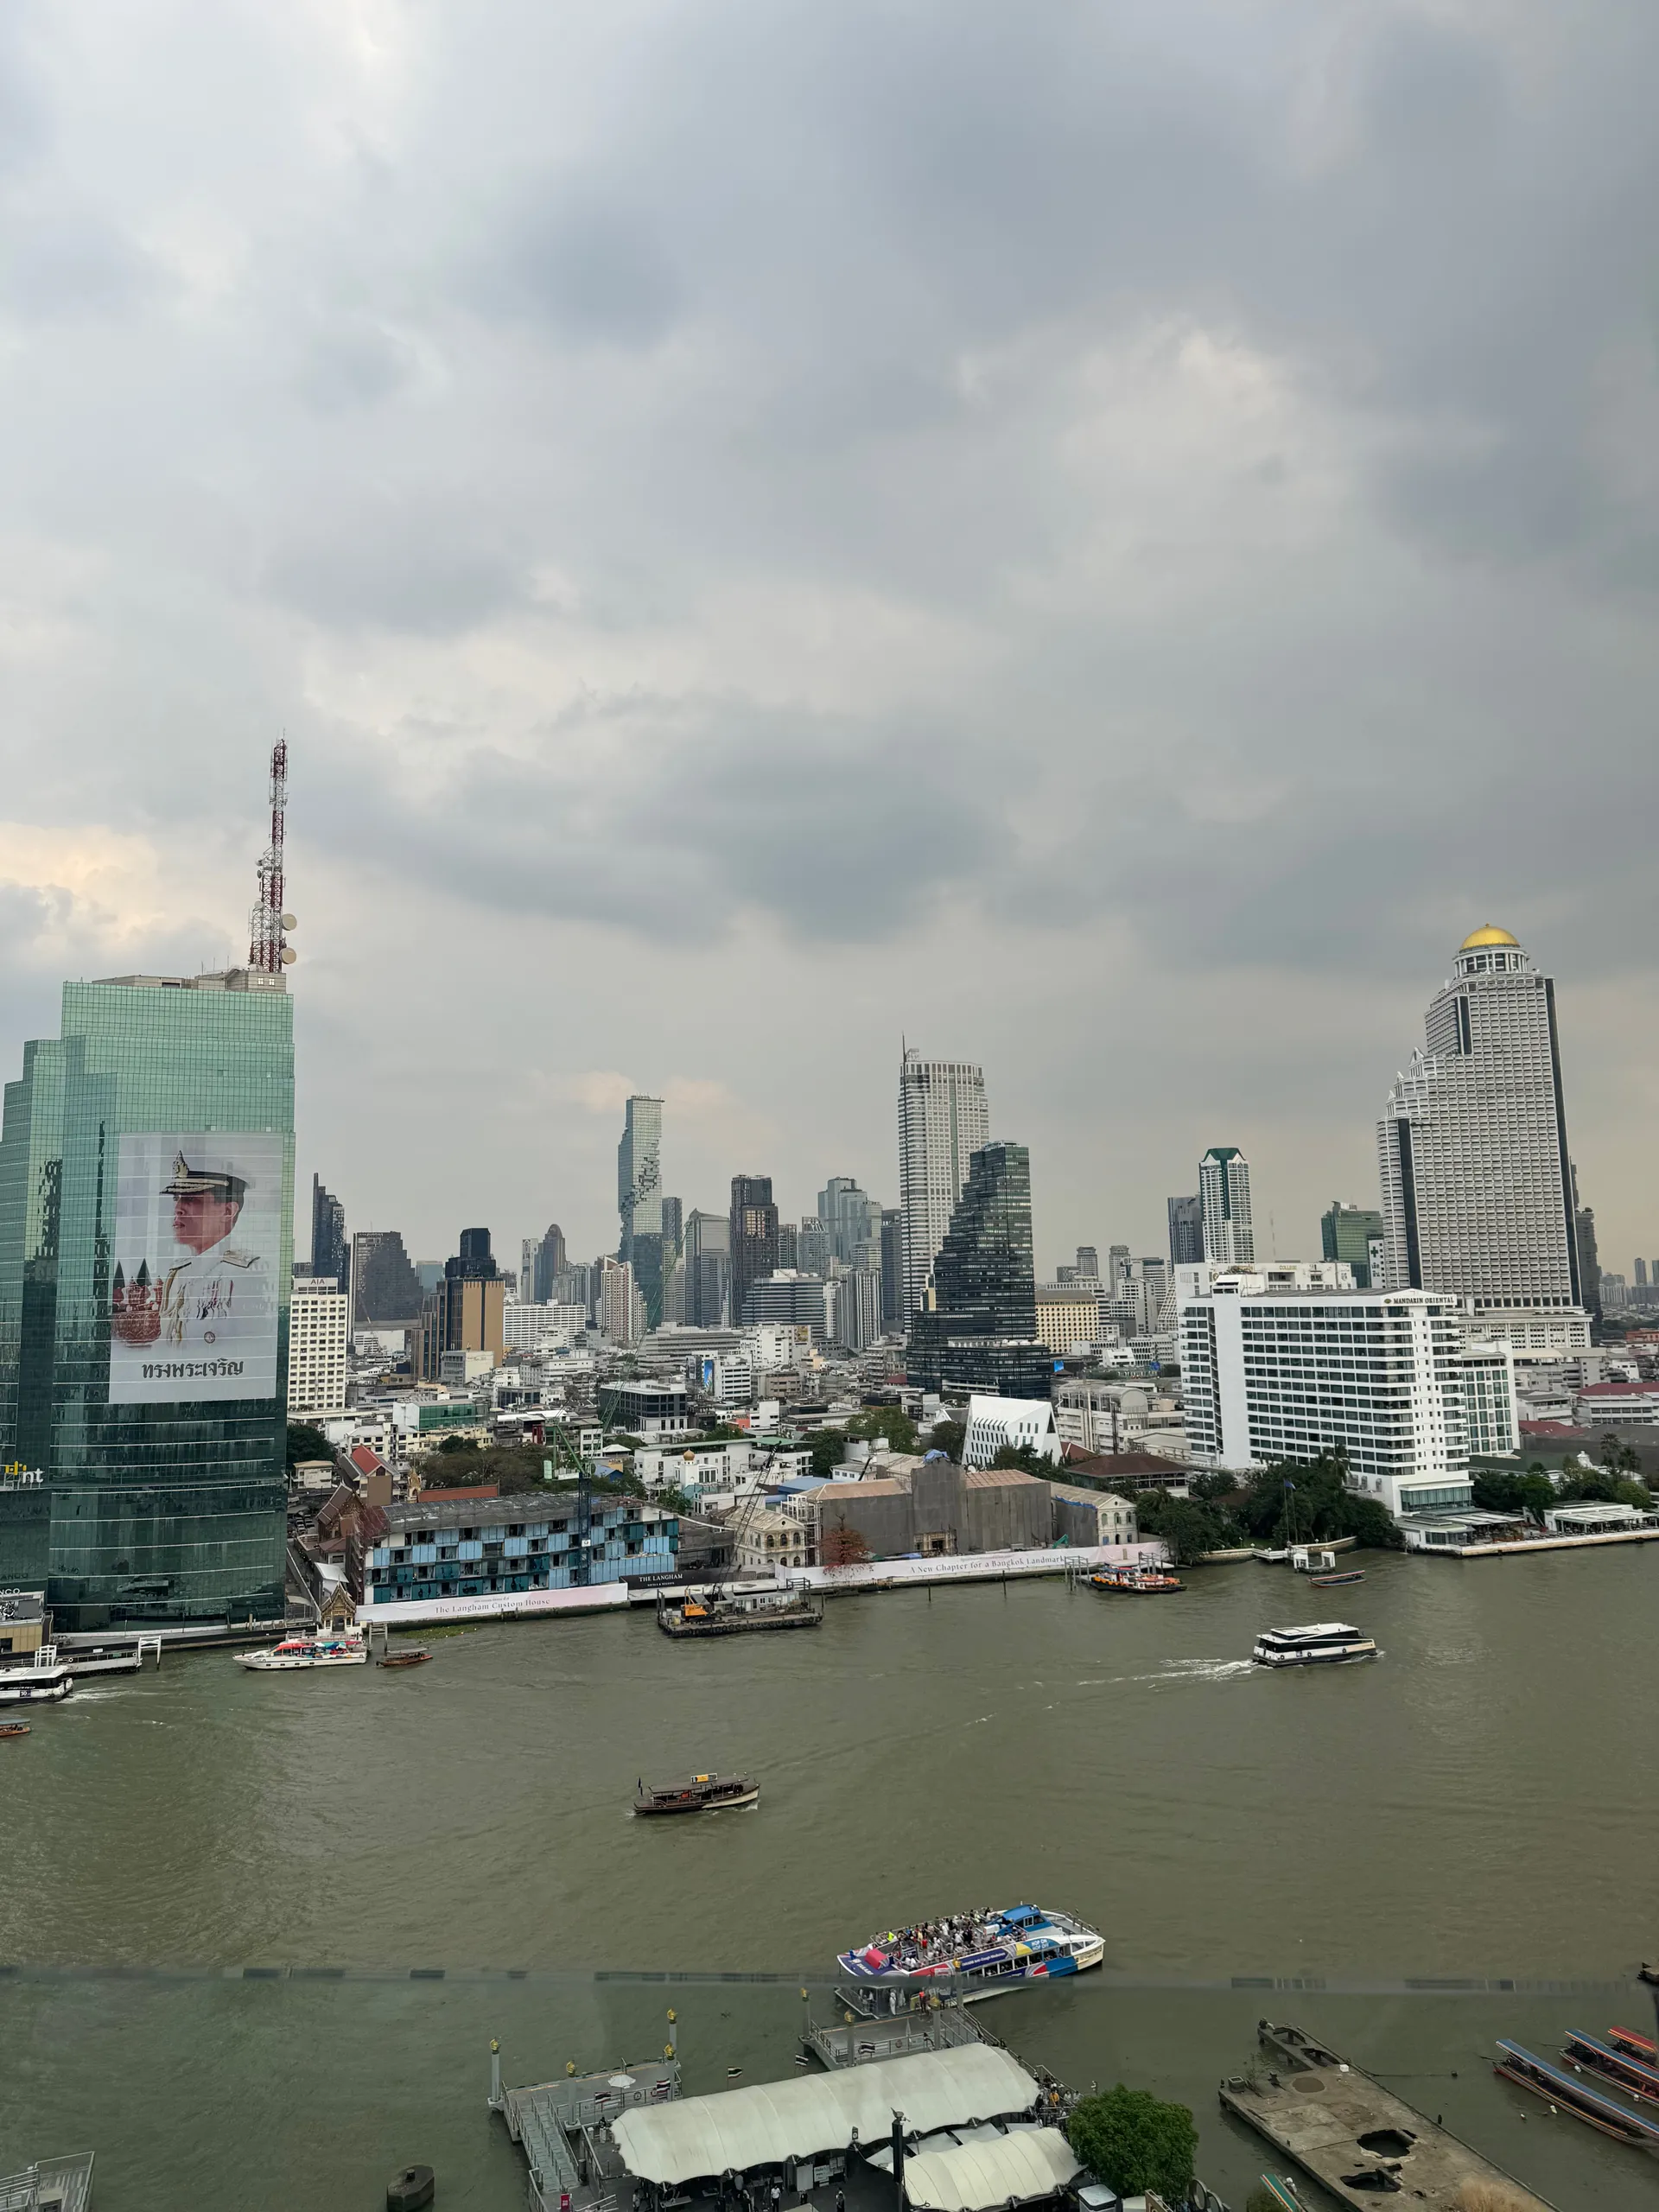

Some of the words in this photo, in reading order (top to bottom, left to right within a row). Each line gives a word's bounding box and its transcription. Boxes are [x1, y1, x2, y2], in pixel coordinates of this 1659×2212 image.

[142, 1357, 244, 1378] ทรงพระเจริญ
[22, 1468, 43, 1484] nt
[936, 1563, 967, 1573] Chapter
[970, 1560, 982, 1569] for
[992, 1558, 1025, 1568] Bangkok
[1027, 1555, 1065, 1565] Landmark
[452, 1604, 489, 1614] Langham
